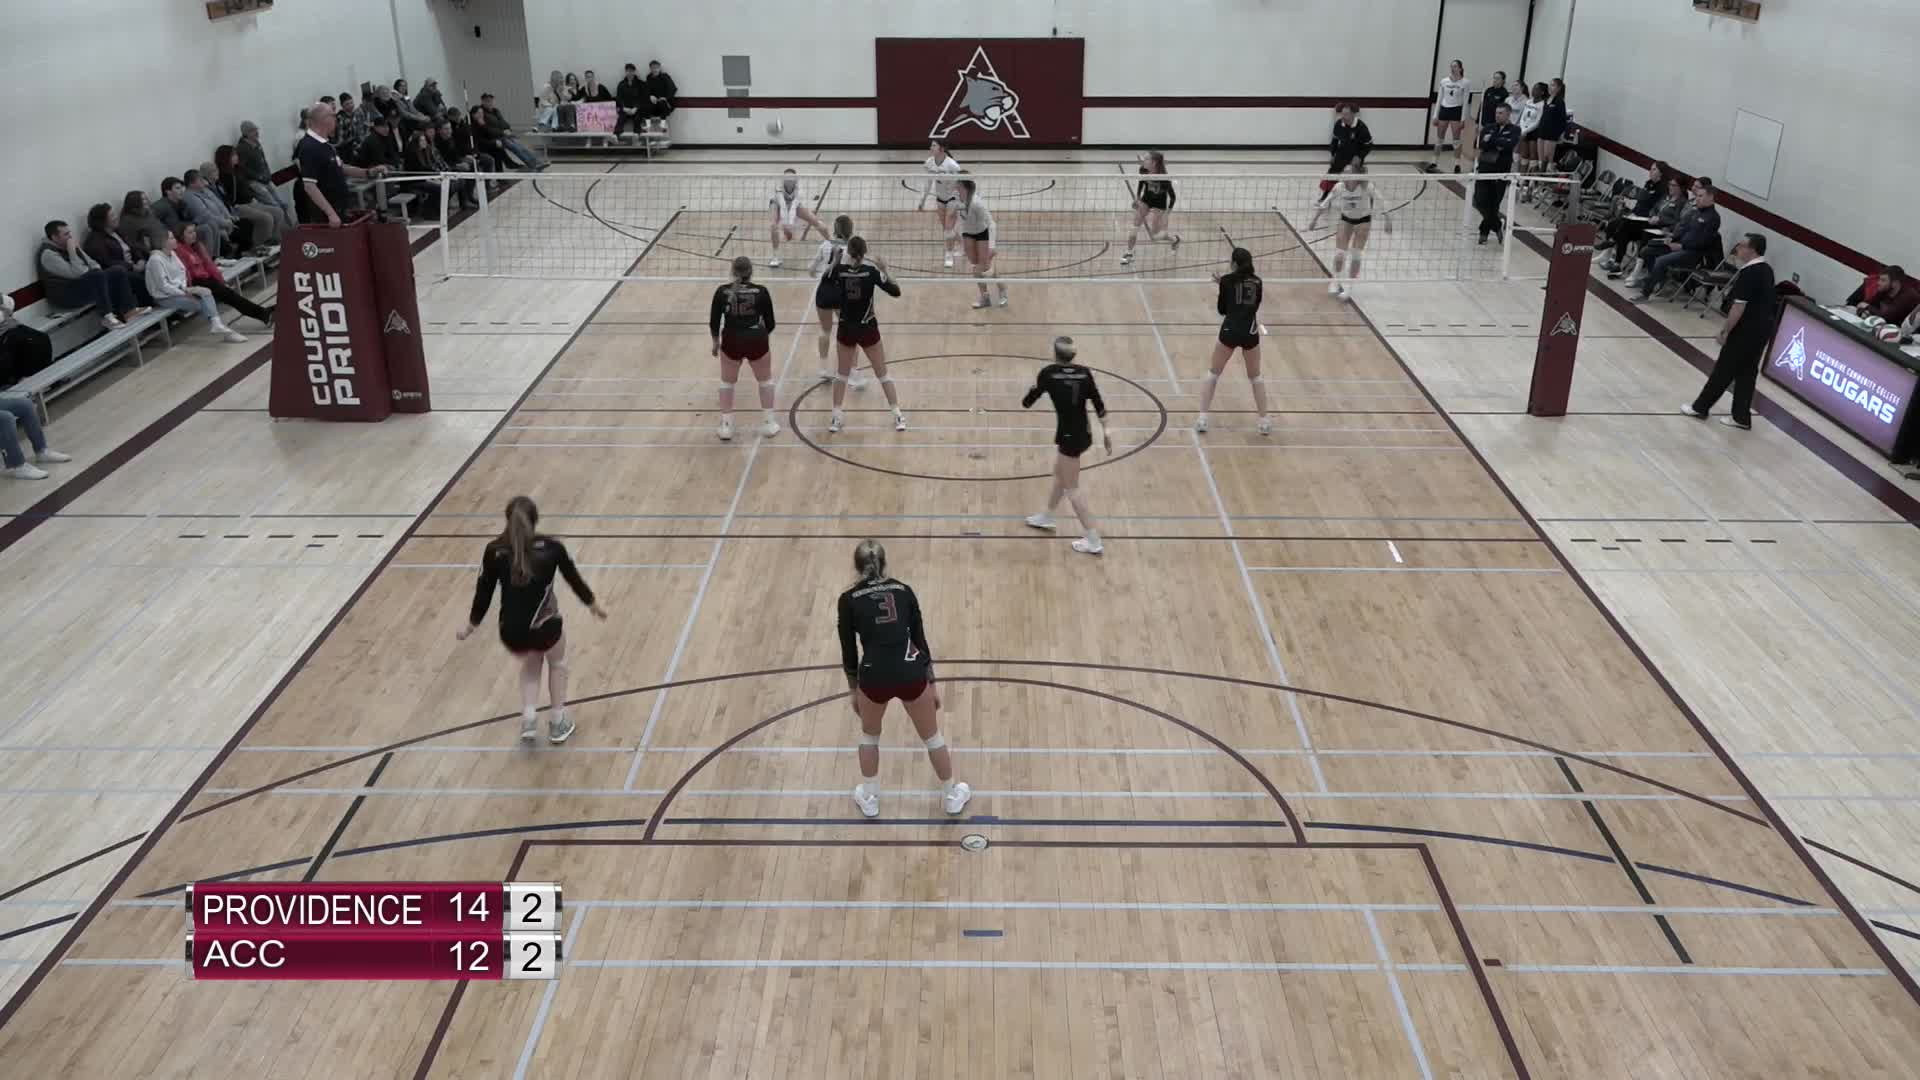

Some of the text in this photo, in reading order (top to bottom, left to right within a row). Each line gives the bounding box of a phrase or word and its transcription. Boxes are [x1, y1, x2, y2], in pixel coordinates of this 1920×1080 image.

[1235, 281, 1258, 305] 13
[293, 271, 332, 406] COUGAR
[315, 271, 361, 406] PRIDE
[1809, 359, 1897, 424] COUGARS
[874, 592, 898, 624] 3
